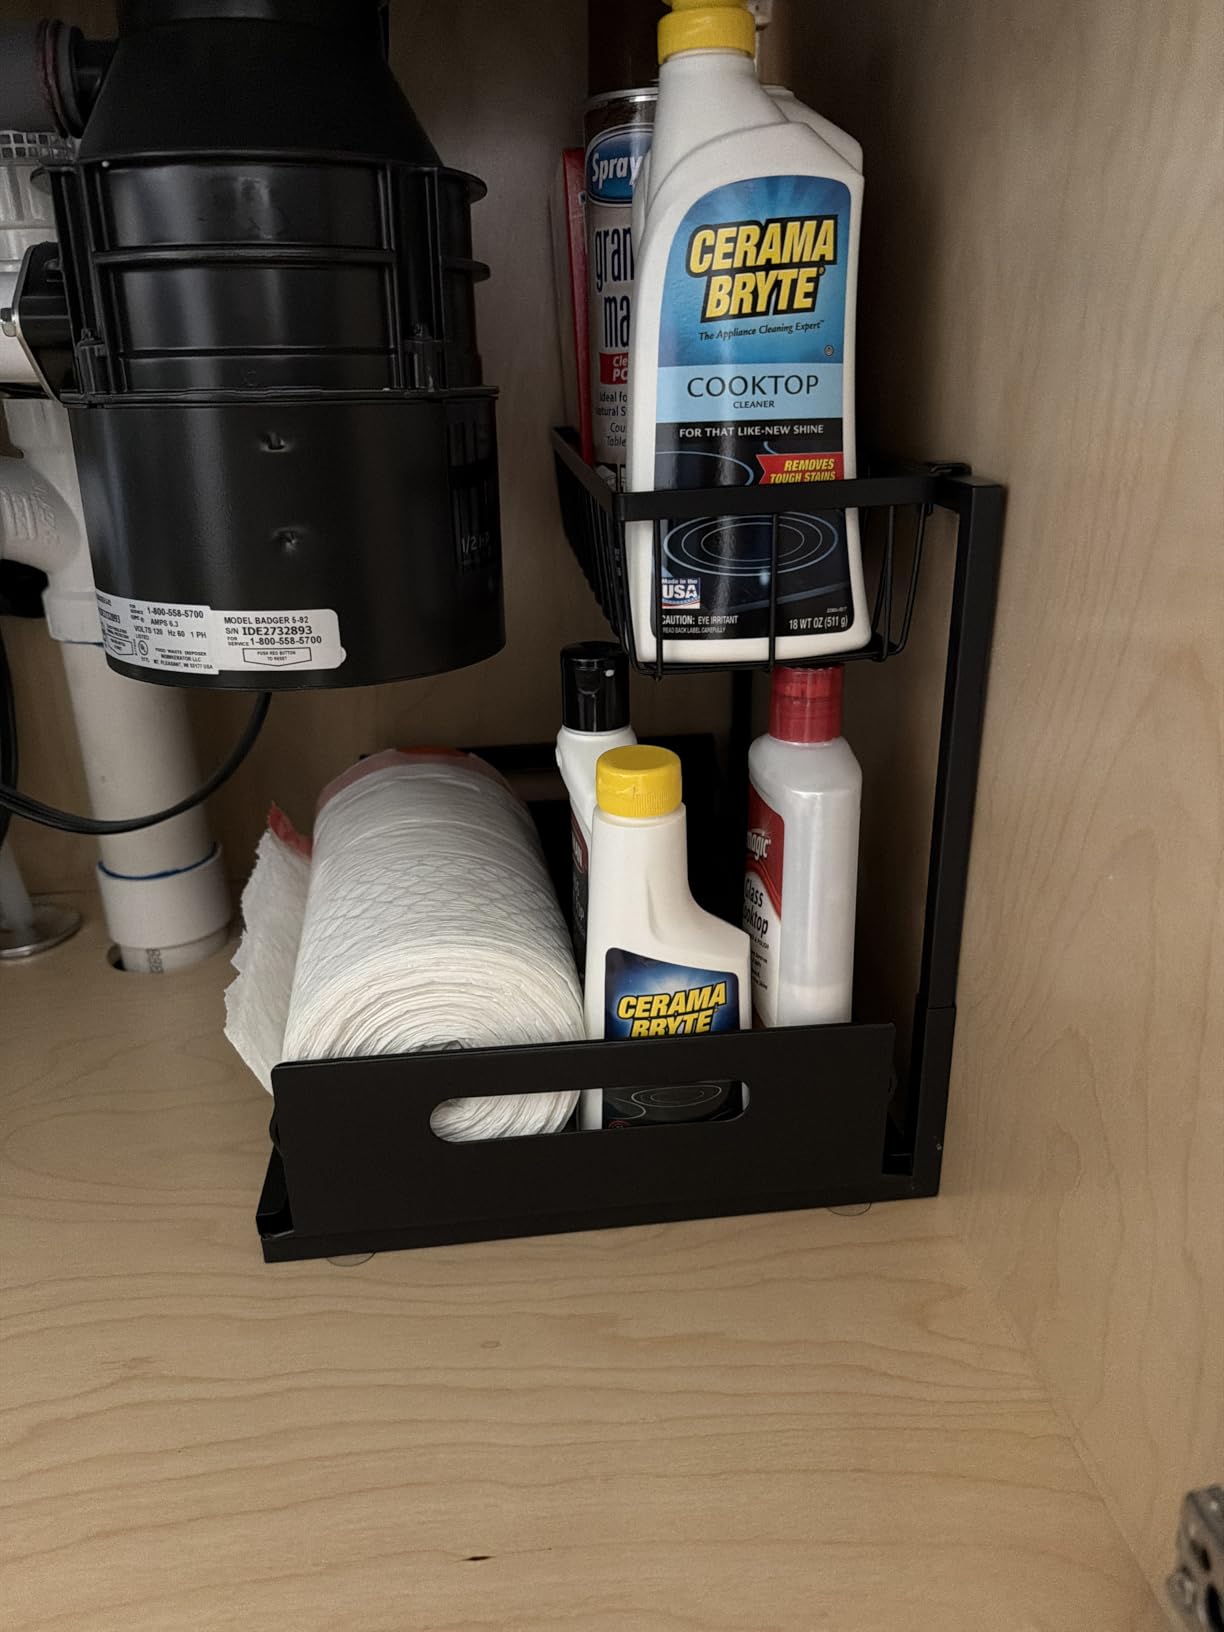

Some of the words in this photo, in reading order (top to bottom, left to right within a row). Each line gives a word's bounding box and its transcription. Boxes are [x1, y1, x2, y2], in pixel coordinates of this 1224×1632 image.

[688, 218, 836, 275] CERAMA
[699, 331, 714, 341] The
[716, 328, 757, 341] Appliance
[759, 323, 793, 335] Cleaning
[687, 374, 819, 398] COOKTOP
[733, 400, 775, 409] CLEANER
[679, 428, 702, 438] FOR
[705, 427, 735, 437] THAT
[793, 424, 824, 434] SHINE
[784, 459, 835, 472] REMOVES
[770, 473, 802, 484] TOUGH
[804, 471, 836, 482] STAINS
[662, 584, 698, 599] USA
[147, 607, 204, 619] 1-800-558-5700
[151, 618, 169, 627] AMPS
[224, 616, 253, 624] MODEL
[255, 616, 290, 625] BADGER
[697, 615, 709, 625] EYE
[710, 615, 738, 625] IRRITANT
[789, 619, 798, 630] 18
[800, 617, 812, 629] WT
[813, 617, 824, 628] OZ
[824, 616, 839, 629] (511
[840, 615, 848, 628] g)
[134, 625, 152, 634] VOLTS
[168, 629, 176, 637] Hz
[225, 627, 239, 635] S/N
[242, 625, 313, 636] IDE2732893
[251, 635, 322, 646] 1-800-558-5700
[618, 982, 726, 1019] CERAMA
